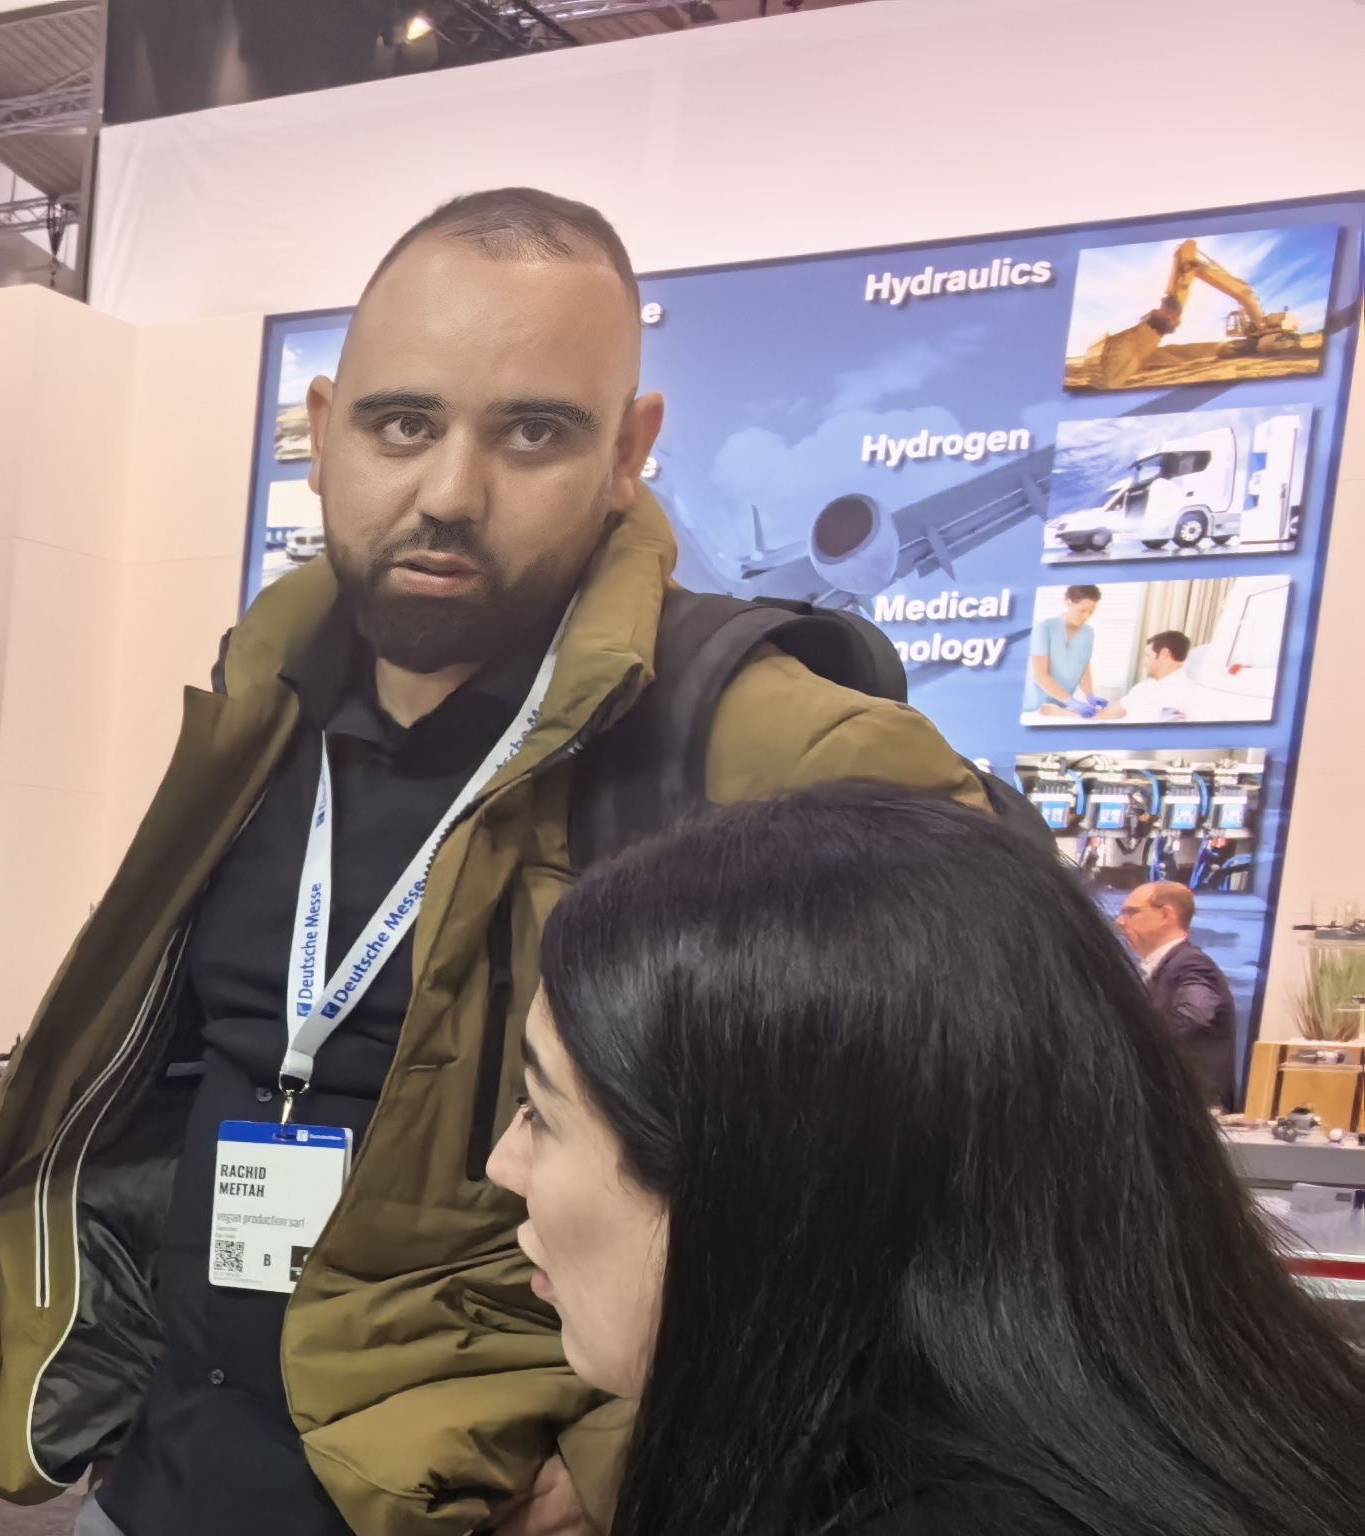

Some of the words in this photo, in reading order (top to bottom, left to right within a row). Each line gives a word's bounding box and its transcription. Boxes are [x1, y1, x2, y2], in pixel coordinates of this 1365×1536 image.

[865, 258, 1053, 304] Hydraulics
[861, 428, 1030, 468] Hydrogen
[874, 589, 1011, 623] Medical
[304, 882, 323, 928] Messe
[333, 930, 391, 1005] Deutsche
[383, 879, 426, 932] Messe
[298, 929, 319, 1001] Deutsche
[219, 1181, 265, 1198] MEFTAH
[220, 1164, 267, 1180] RACHID
[263, 1253, 272, 1267] B
